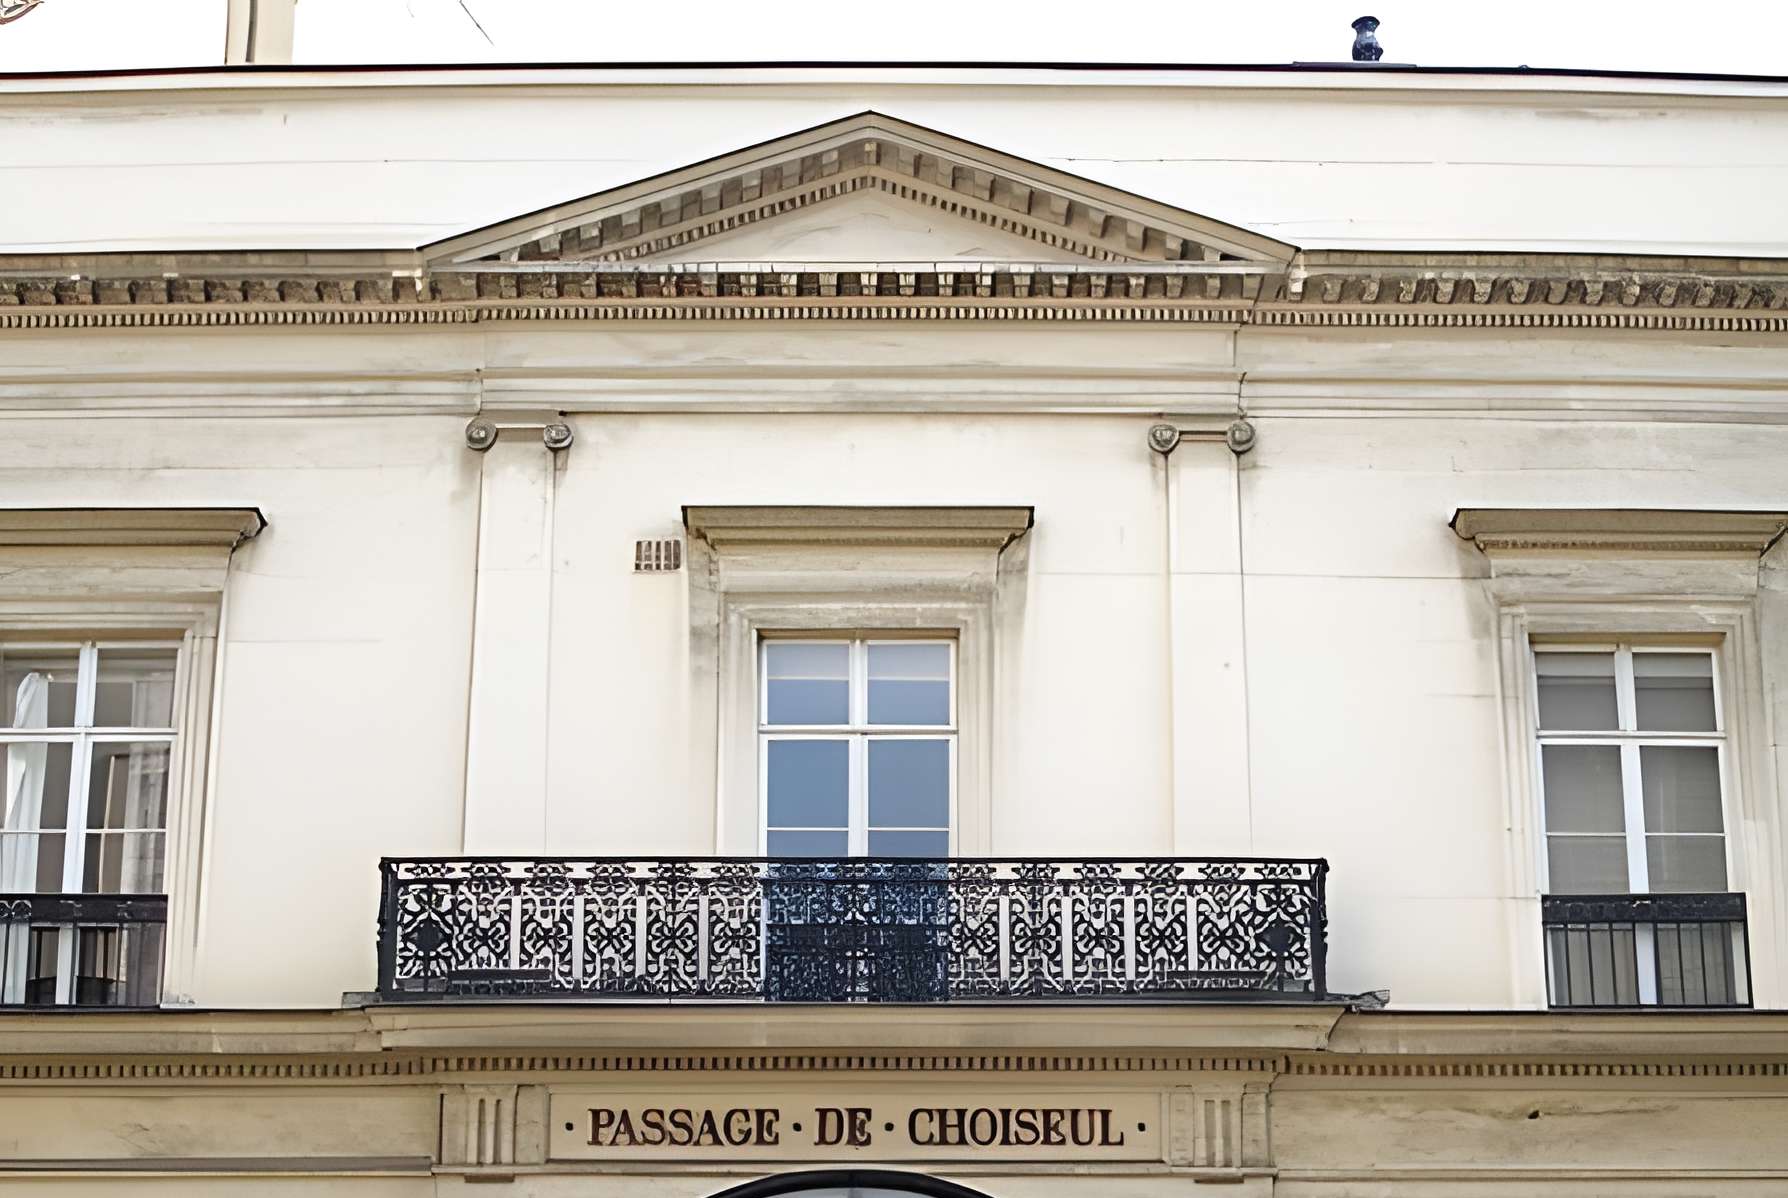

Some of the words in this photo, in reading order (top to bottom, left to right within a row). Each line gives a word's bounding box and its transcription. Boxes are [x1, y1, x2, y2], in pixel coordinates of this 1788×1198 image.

[587, 1108, 780, 1147] PASSAGE
[814, 1108, 873, 1147] DE
[908, 1108, 1125, 1147] CHOISEUL
